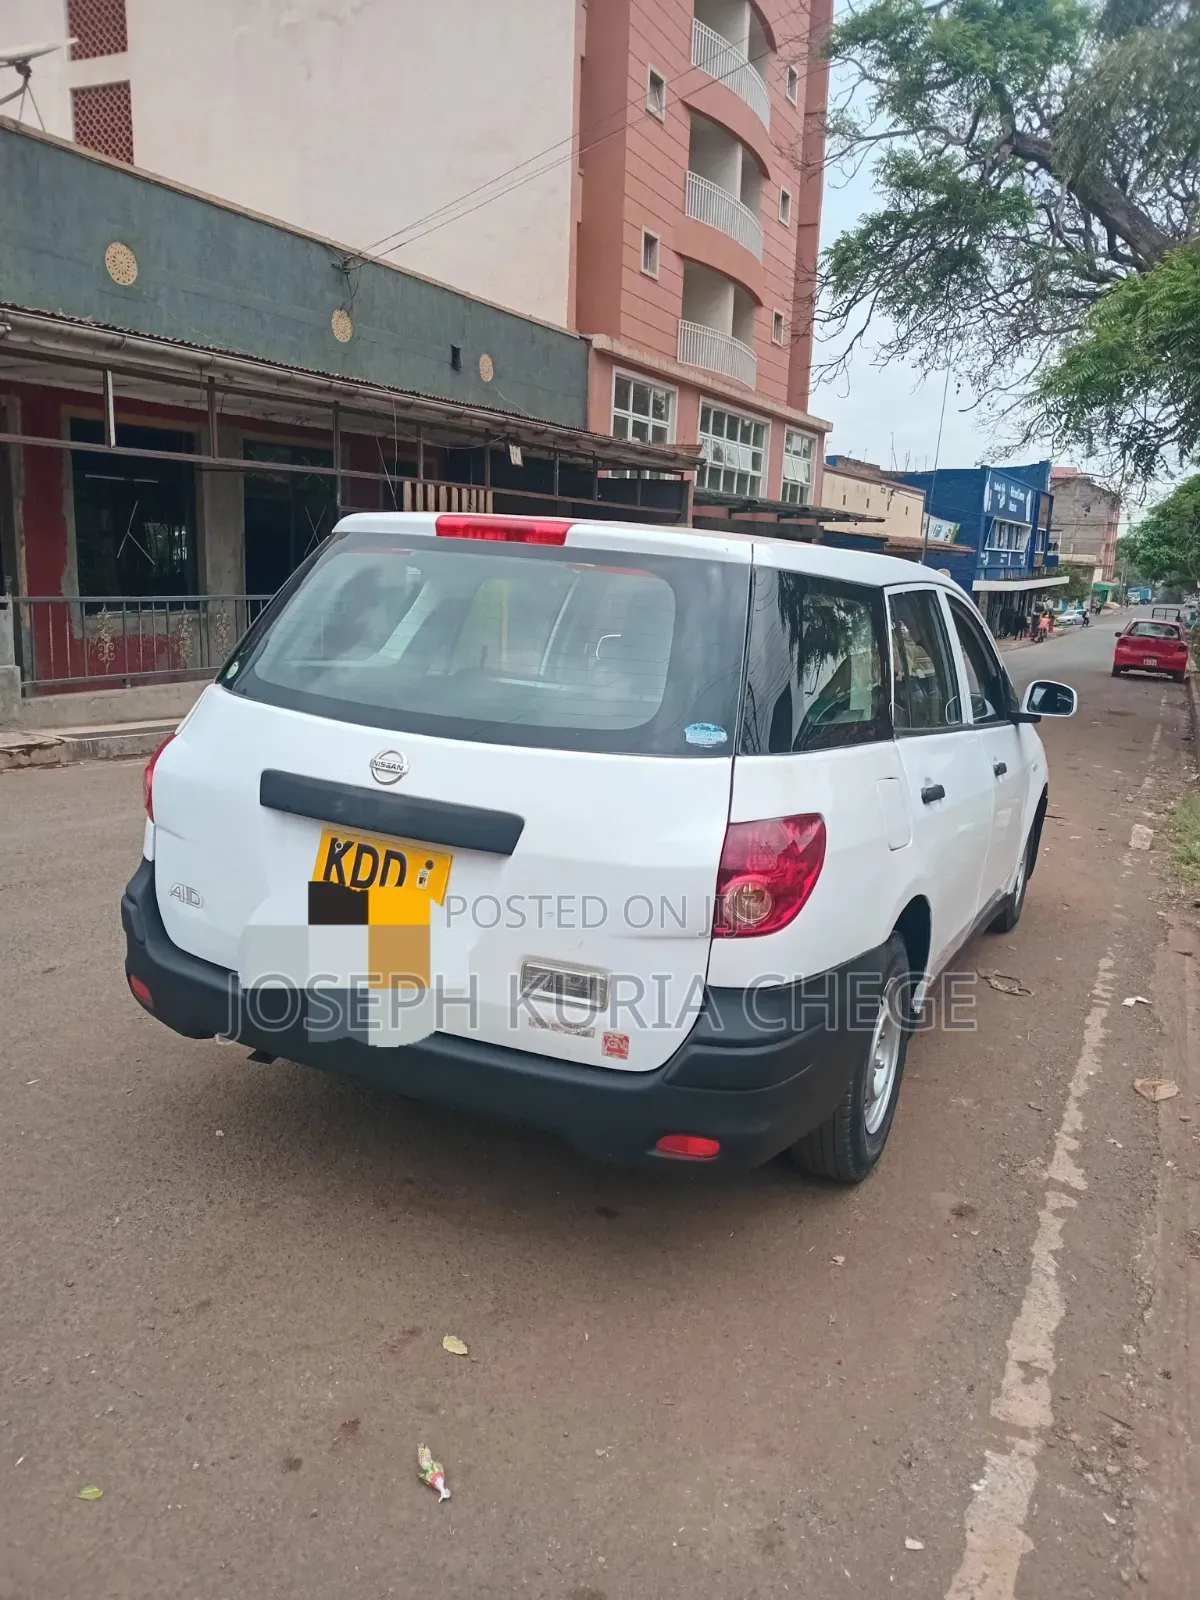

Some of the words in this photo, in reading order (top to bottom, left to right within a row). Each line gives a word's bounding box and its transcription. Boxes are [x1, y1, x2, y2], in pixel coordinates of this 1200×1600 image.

[372, 759, 405, 772] NISSAN
[322, 837, 408, 889] KDD
[168, 882, 205, 909] AD
